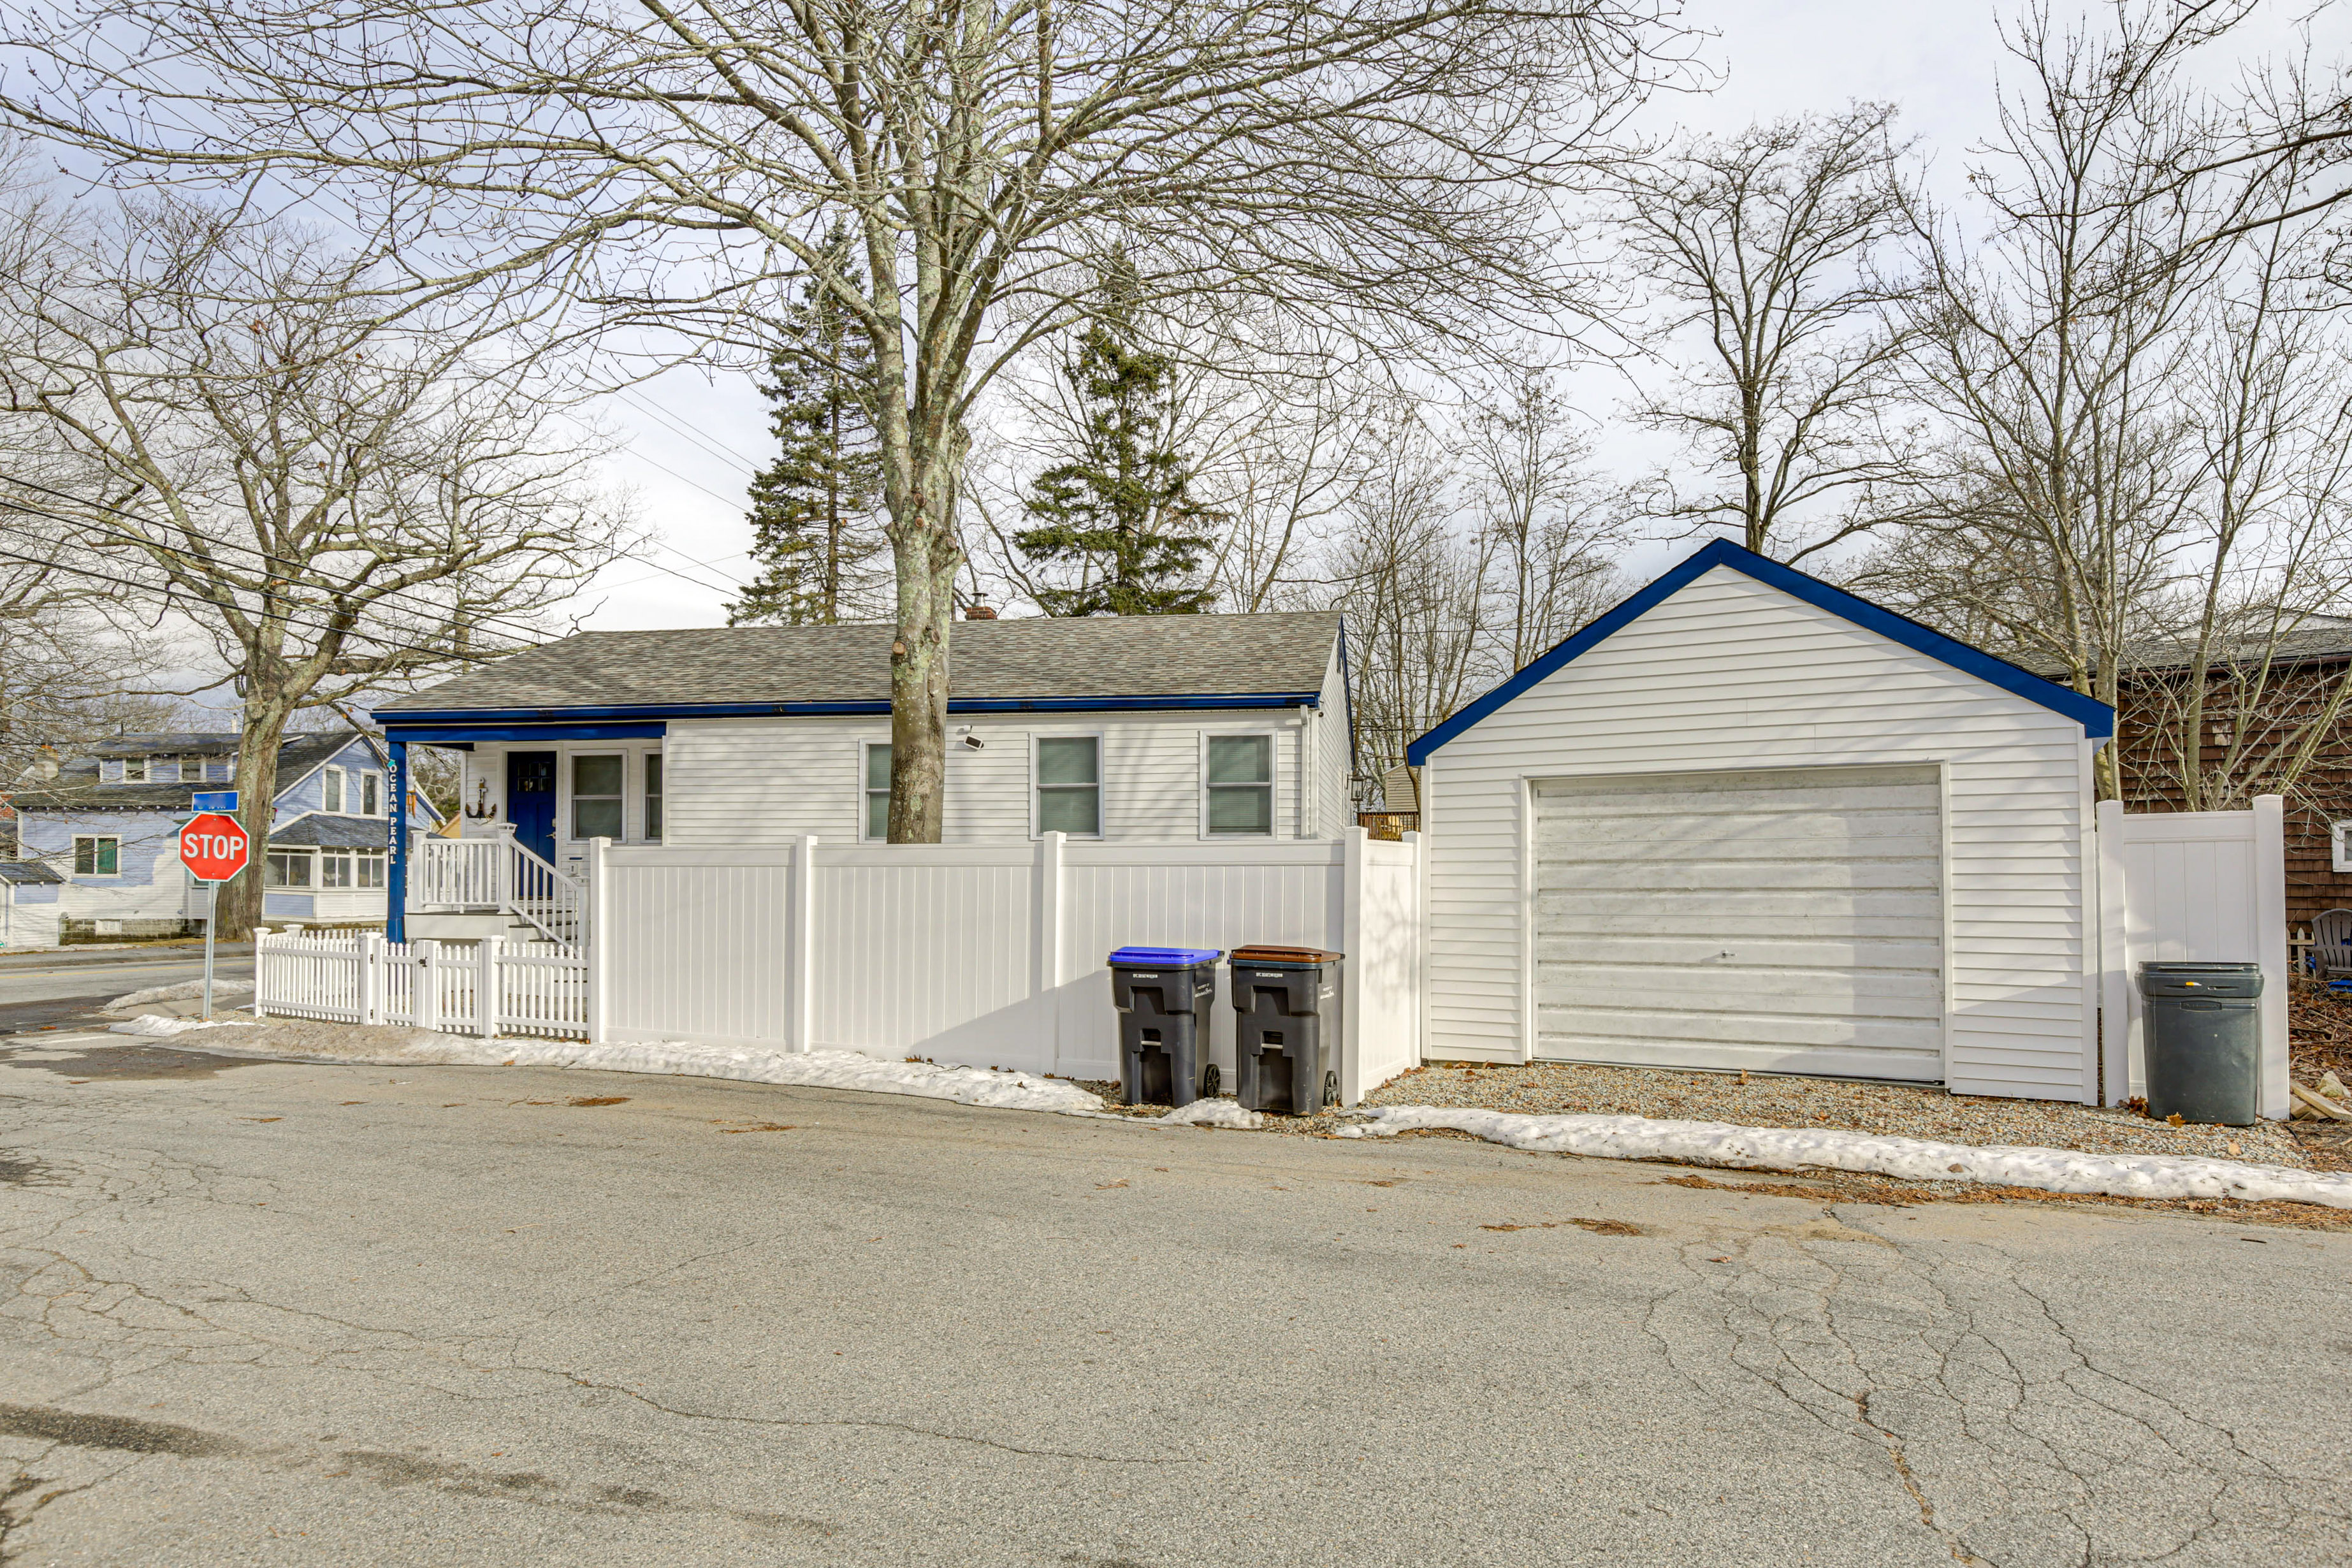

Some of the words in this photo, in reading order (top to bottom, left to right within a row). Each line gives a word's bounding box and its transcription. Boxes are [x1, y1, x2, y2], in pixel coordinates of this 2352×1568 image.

[389, 764, 398, 813] OCEAN
[184, 833, 244, 860] STOP
[389, 817, 398, 864] PEARL
